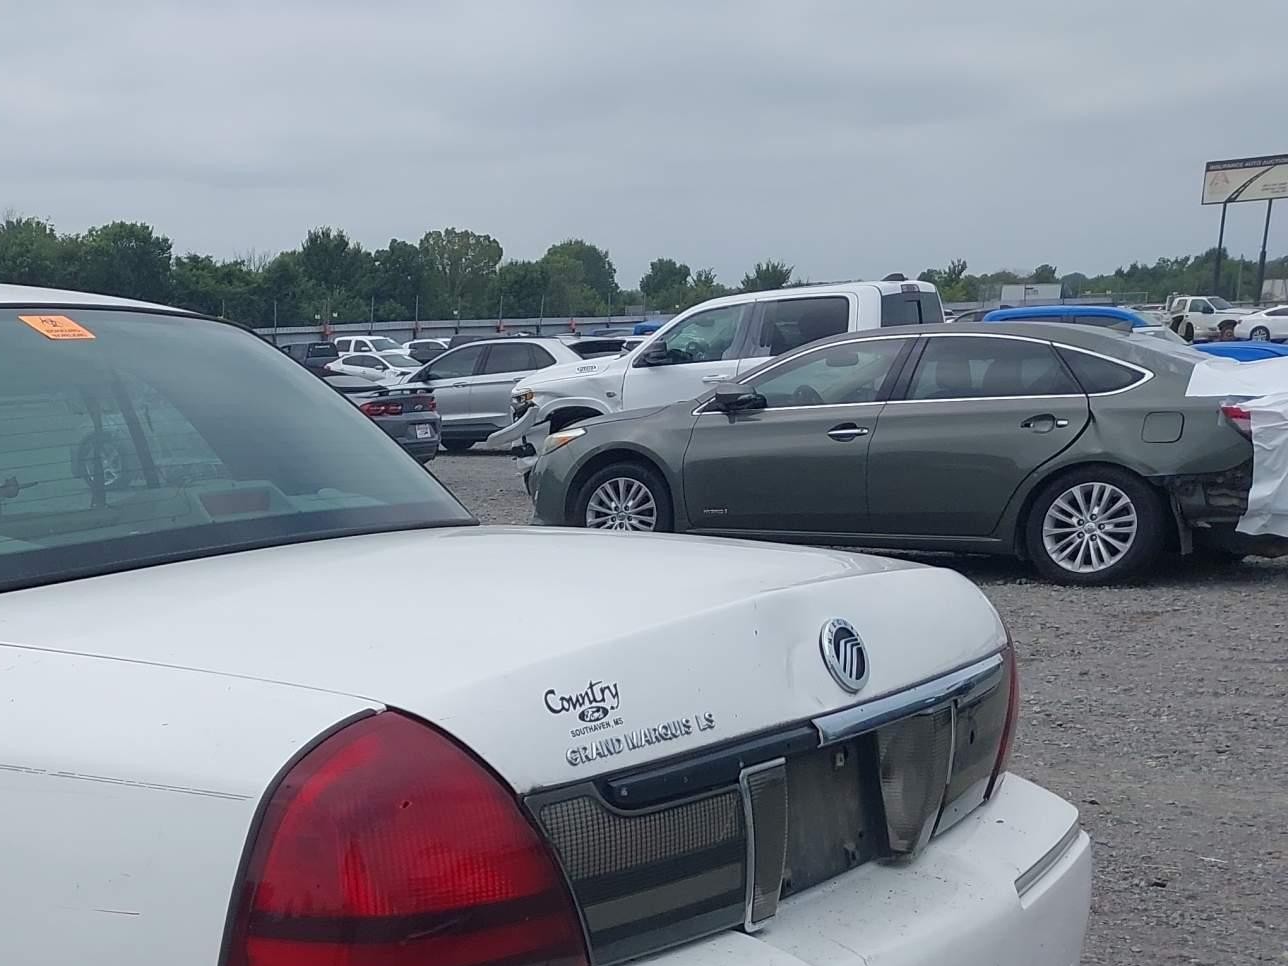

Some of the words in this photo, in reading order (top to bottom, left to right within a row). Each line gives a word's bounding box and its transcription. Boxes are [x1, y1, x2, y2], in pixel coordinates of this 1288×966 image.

[543, 680, 620, 714] Country
[566, 738, 624, 766] GRAND
[624, 718, 693, 751] MARQUIS
[695, 712, 716, 732] LS
